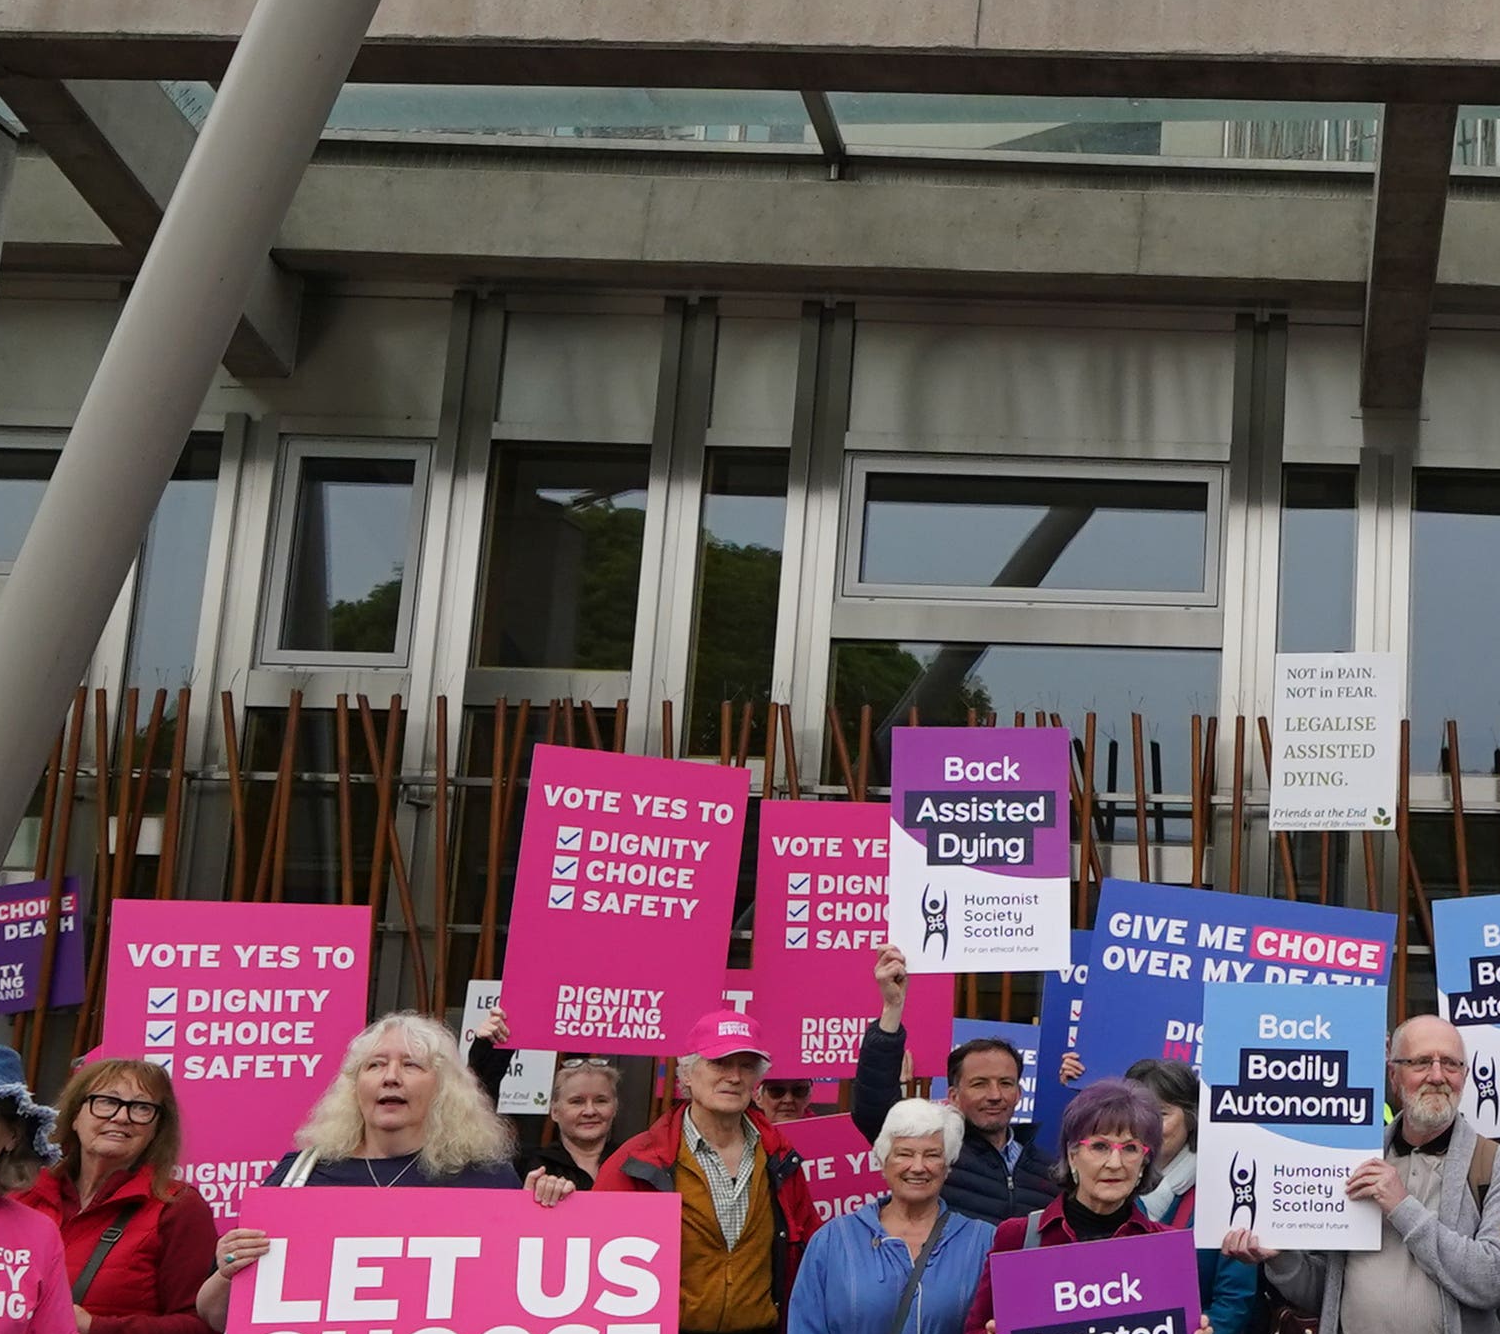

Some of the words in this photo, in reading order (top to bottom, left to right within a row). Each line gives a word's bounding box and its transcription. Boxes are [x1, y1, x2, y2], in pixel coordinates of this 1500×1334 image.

[1287, 669, 1317, 679] NOT
[1321, 668, 1333, 678] in
[1338, 668, 1375, 678] PAIN.
[1286, 687, 1316, 698] NOT
[1320, 687, 1332, 697] in
[1337, 687, 1376, 698] FEAR.
[1286, 717, 1376, 731] LEGALISE
[1284, 744, 1375, 759] ASSISTED
[943, 756, 1020, 783] Back
[1284, 772, 1348, 787] DYING.
[544, 785, 619, 812] VOTE
[631, 794, 690, 821] YES
[698, 801, 734, 824] TO
[916, 797, 1046, 823] Assisted
[589, 831, 710, 861] DIGNITY
[937, 833, 1025, 865] Dying
[586, 860, 695, 889] CHOICE
[582, 890, 699, 919] SAFETY
[964, 891, 1039, 906] Humanist
[964, 908, 1023, 924] Society
[964, 923, 1034, 938] Scotland
[1108, 912, 1188, 945] GIVE
[1199, 923, 1247, 952] ME
[1256, 929, 1380, 969] CHOICE
[1102, 945, 1190, 981] OVER
[558, 985, 664, 1007] DIGNITY
[555, 1004, 582, 1021] IN
[585, 1005, 661, 1024] DYING
[554, 1021, 666, 1040] SCOTLAND.
[1258, 1014, 1331, 1042] Back
[1247, 1054, 1340, 1086] Bodily
[1216, 1087, 1367, 1122] Autonomy
[250, 1235, 481, 1325] LET
[515, 1235, 662, 1320] US
[1052, 1272, 1142, 1312] Back
